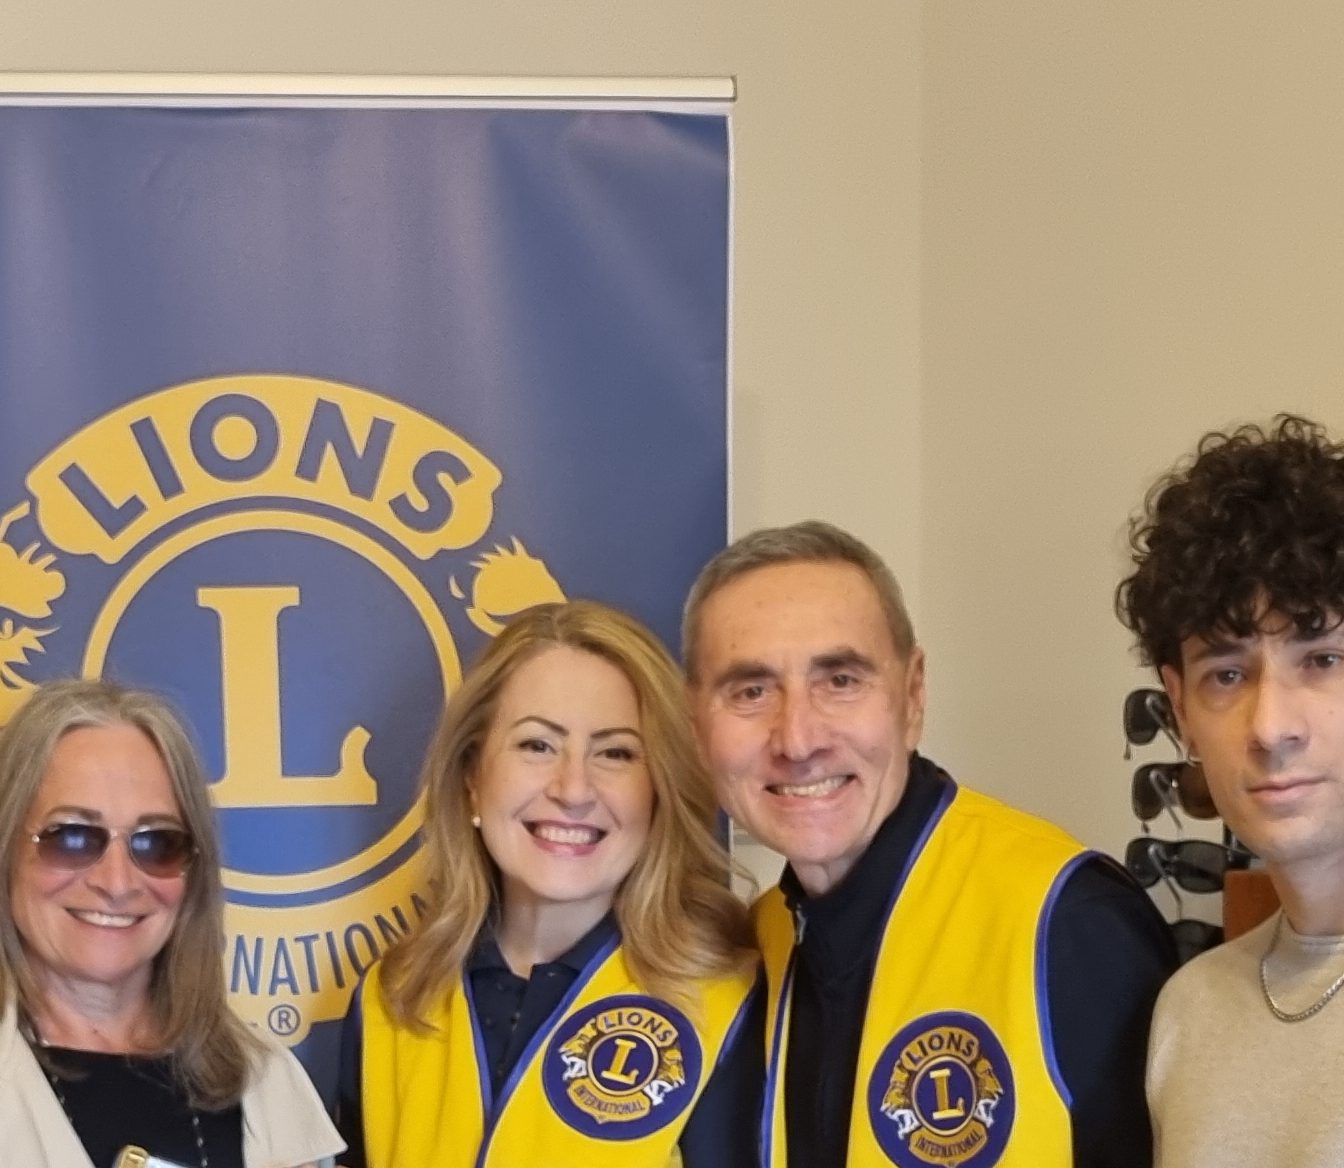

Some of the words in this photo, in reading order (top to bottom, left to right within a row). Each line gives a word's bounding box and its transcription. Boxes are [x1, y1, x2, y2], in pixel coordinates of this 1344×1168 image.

[58, 393, 474, 540] LIONS
[196, 585, 378, 809] L
[603, 1011, 673, 1044] LIONS
[905, 1032, 975, 1066] LIONS
[601, 1038, 639, 1085] L
[575, 1084, 646, 1115] INTERNATIONAL
[929, 1068, 965, 1120] L
